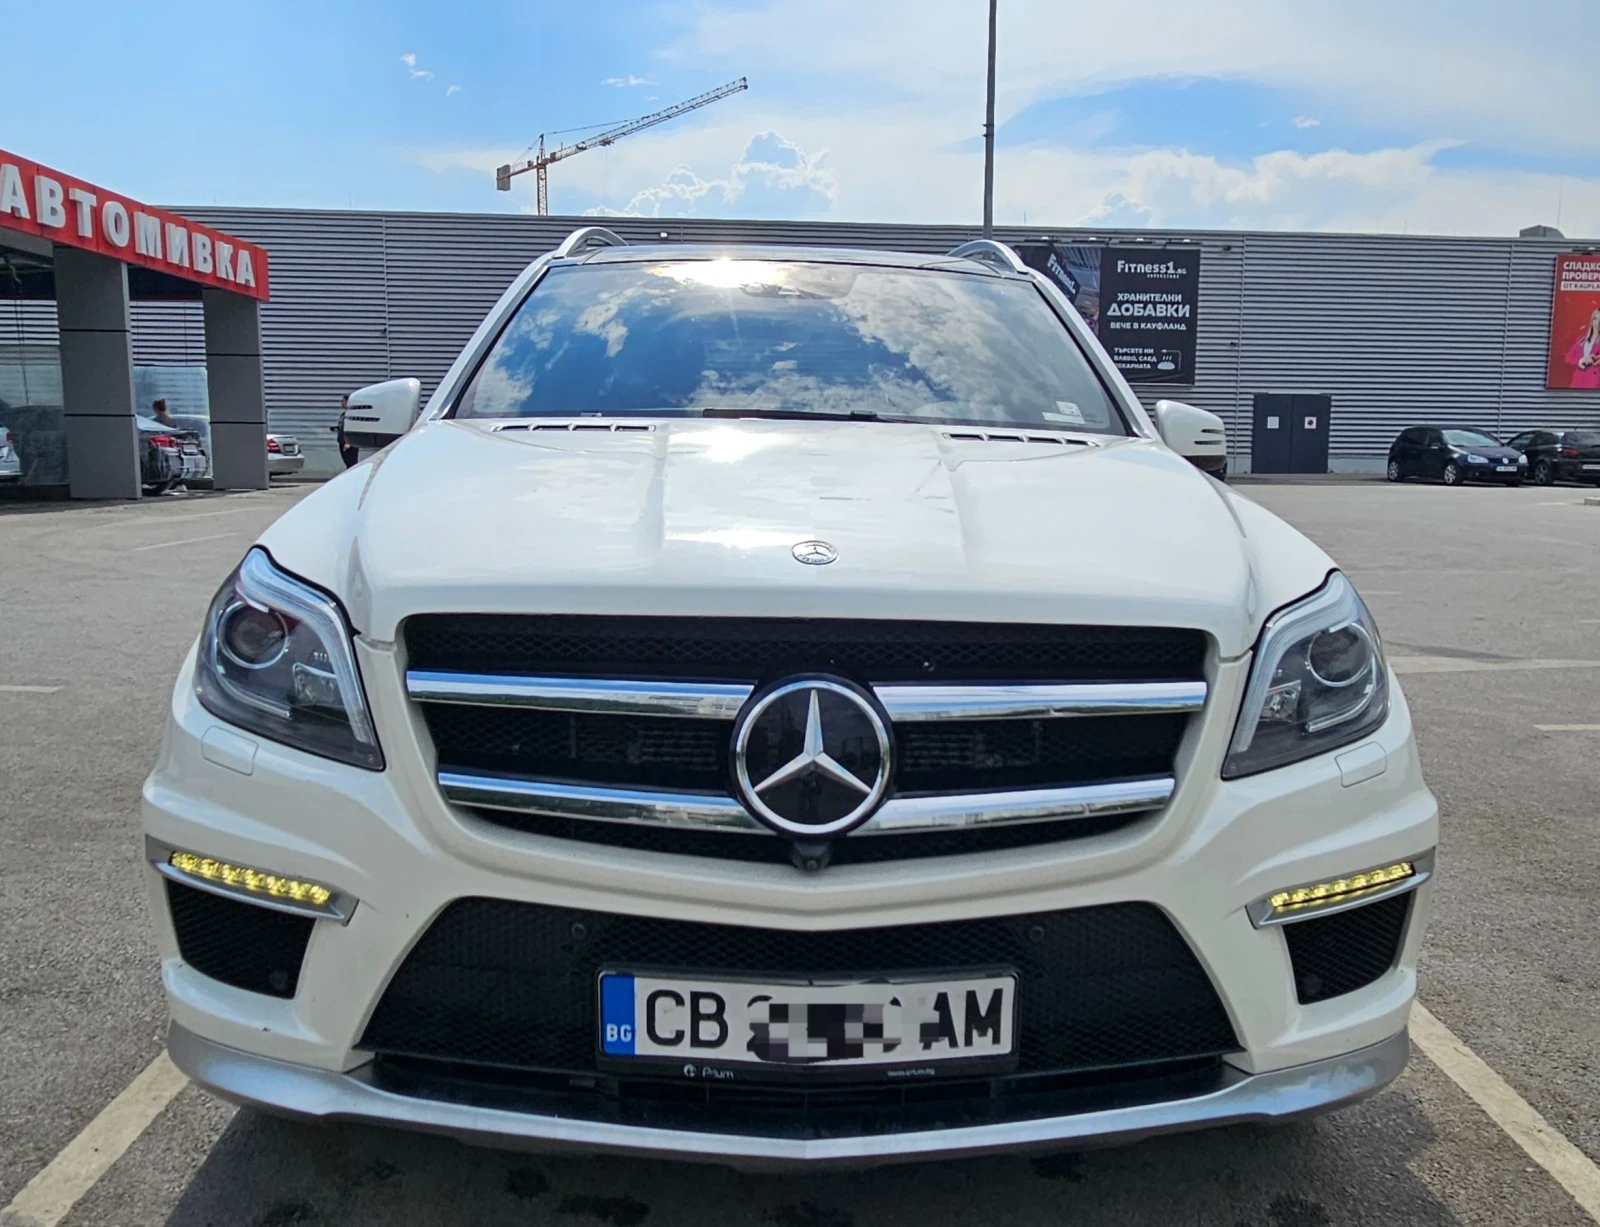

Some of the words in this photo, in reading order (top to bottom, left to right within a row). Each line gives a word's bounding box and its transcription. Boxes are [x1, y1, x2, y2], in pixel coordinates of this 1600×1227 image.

[0, 163, 256, 288] АВТОМИВКА
[1562, 271, 1600, 281] ПРОВЕР
[1117, 292, 1182, 302] ХРАНИТЕЛНИ
[1107, 303, 1190, 317] ДОБАВКИ
[1140, 322, 1187, 330] КАУФЛАНД
[646, 989, 729, 1049] CB
[606, 1023, 632, 1042] BG
